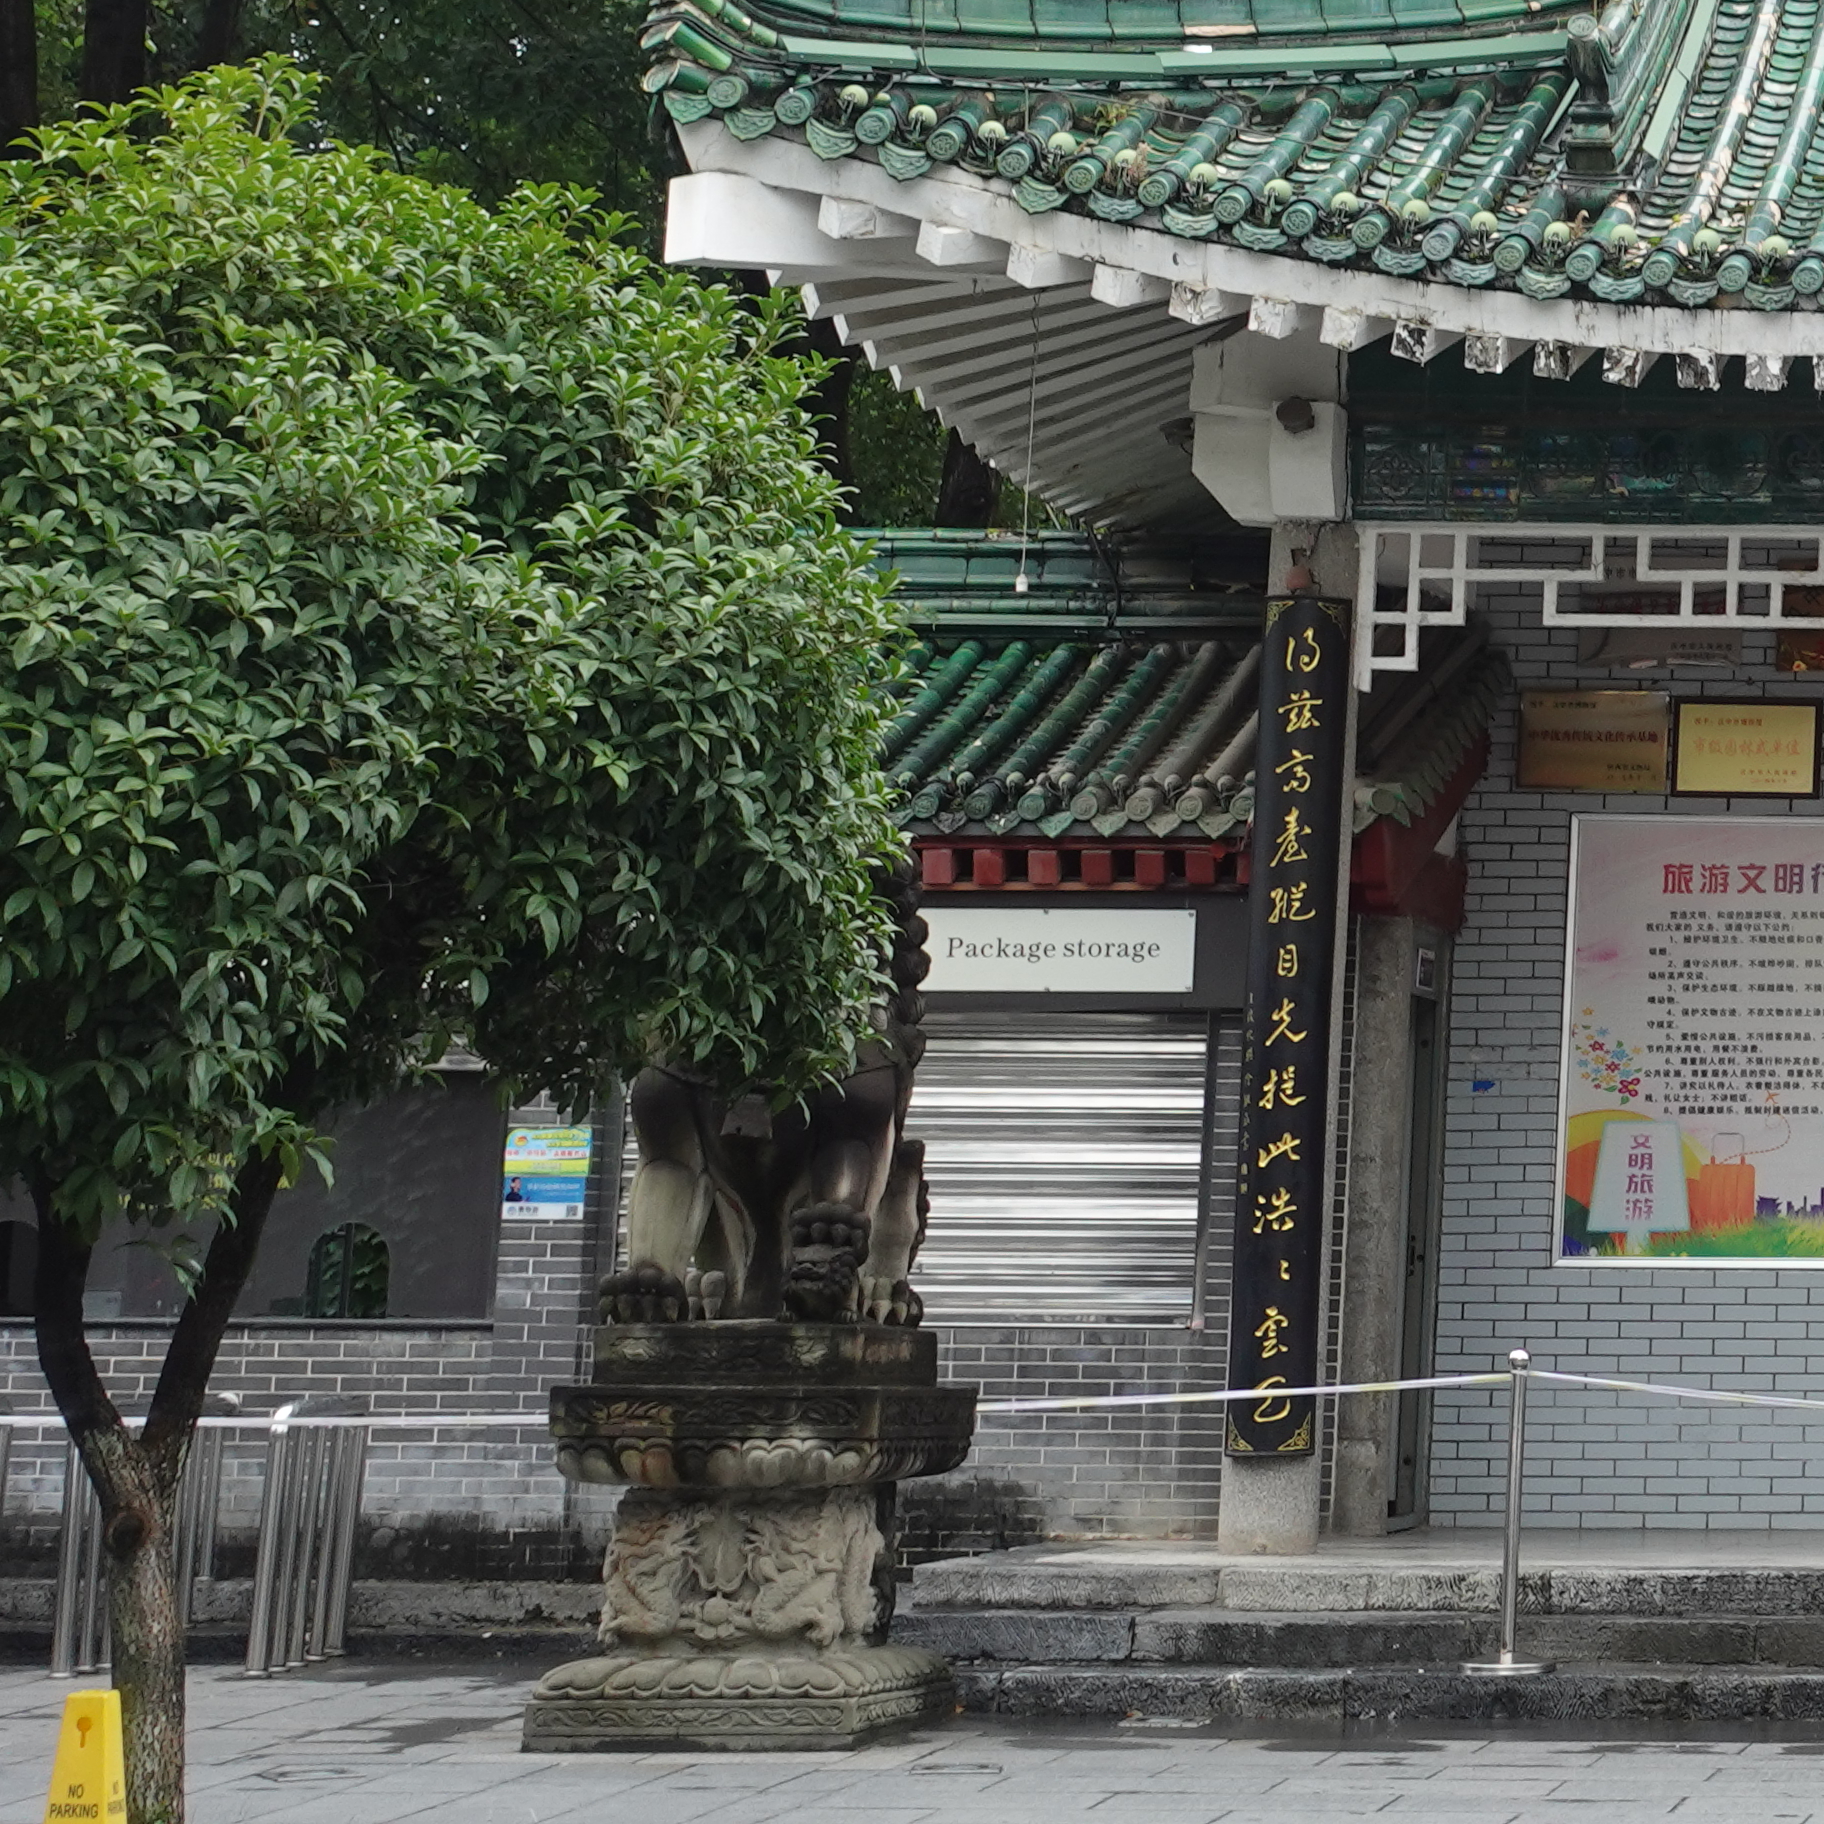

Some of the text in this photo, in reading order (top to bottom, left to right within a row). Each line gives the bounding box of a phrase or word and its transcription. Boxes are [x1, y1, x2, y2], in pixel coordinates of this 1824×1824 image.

[946, 935, 1161, 963] Package storage
[1623, 1132, 1656, 1222] 文明旅游
[67, 1784, 85, 1800] NO
[48, 1802, 99, 1820] PARKING
